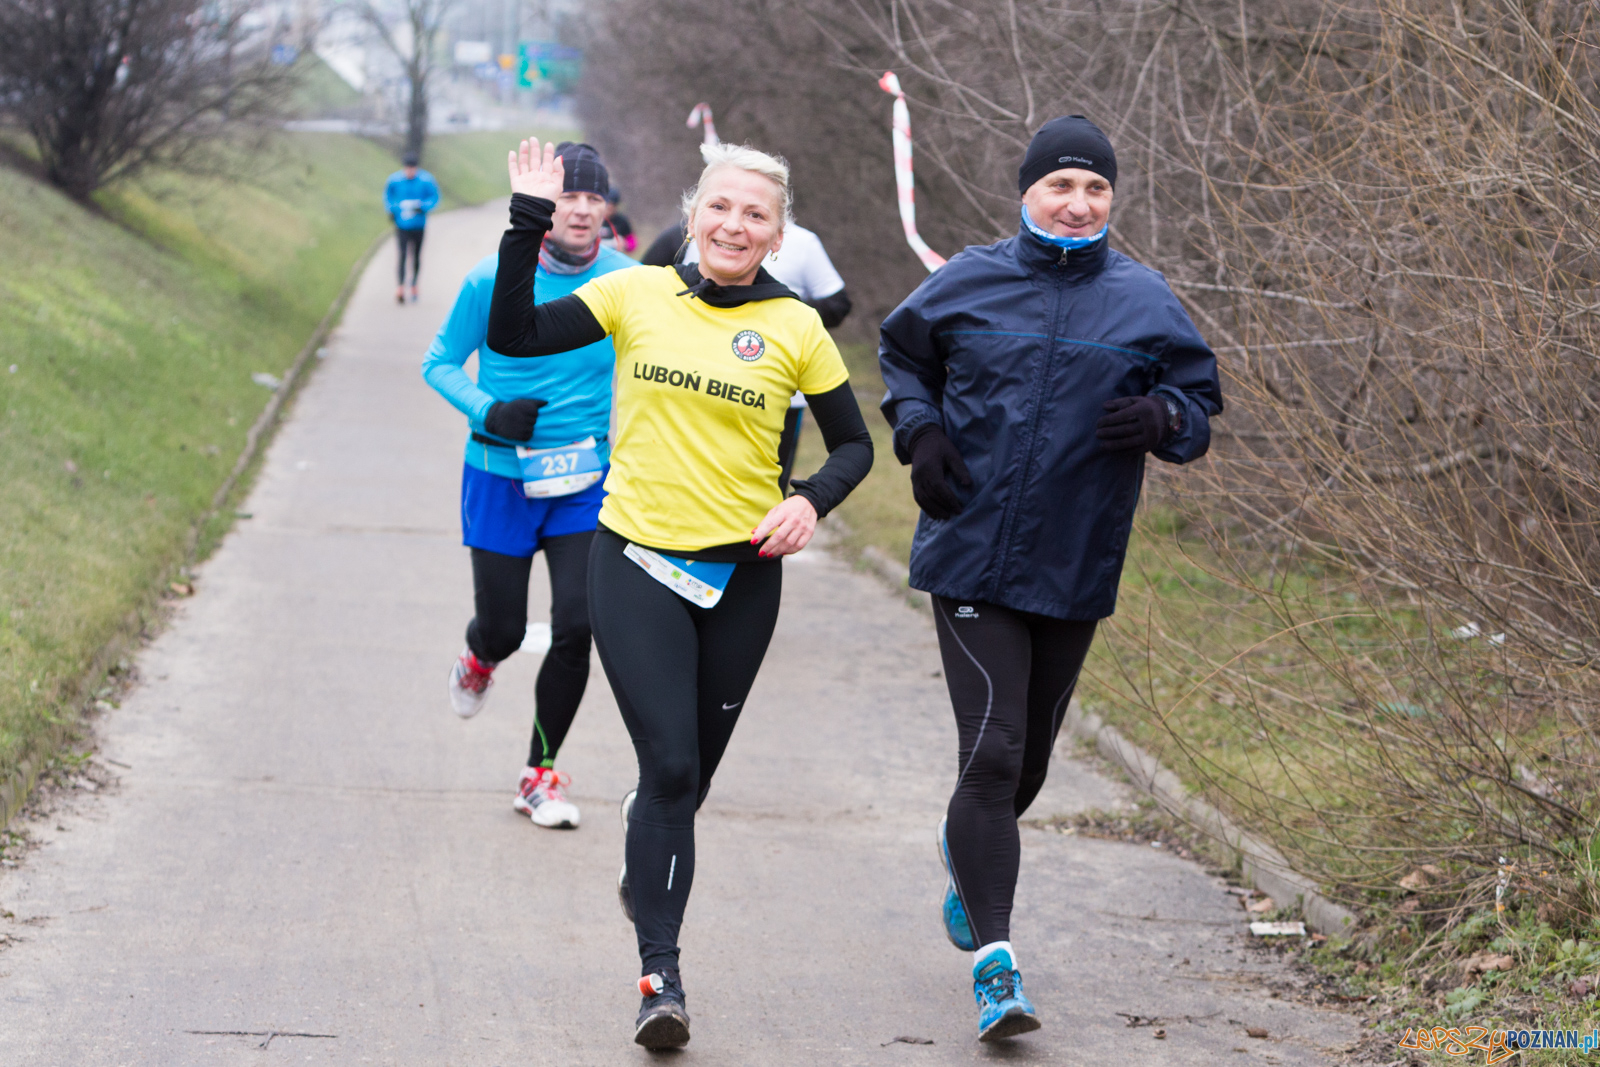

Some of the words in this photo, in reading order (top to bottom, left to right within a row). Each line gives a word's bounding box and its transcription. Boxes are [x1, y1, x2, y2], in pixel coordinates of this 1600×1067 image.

[633, 362, 701, 391] LUBOŃ
[706, 378, 766, 410] BIEGA
[541, 452, 578, 476] 237
